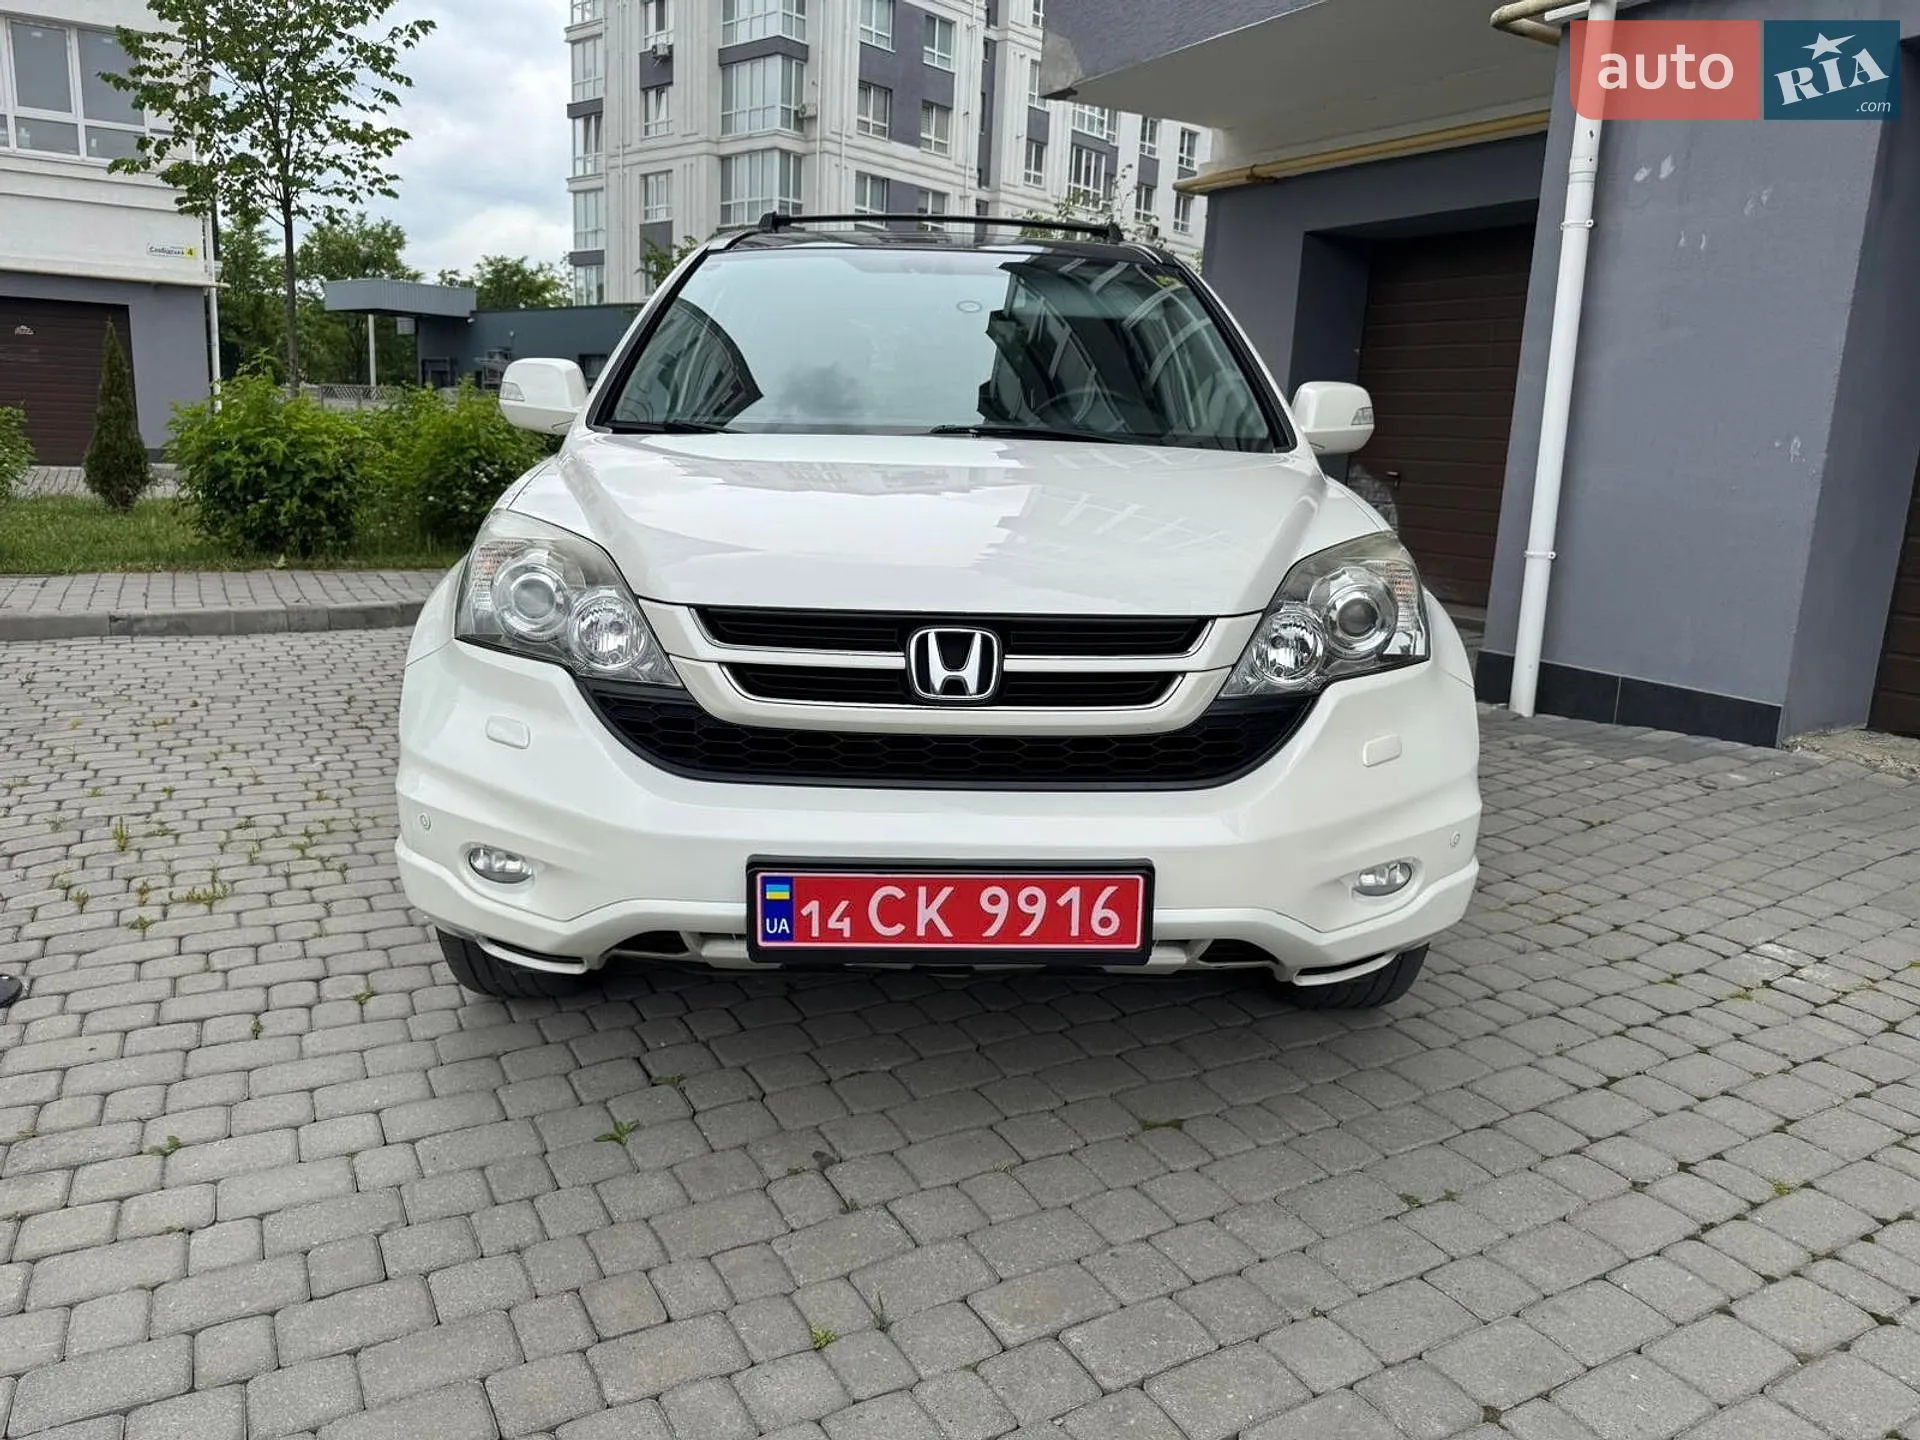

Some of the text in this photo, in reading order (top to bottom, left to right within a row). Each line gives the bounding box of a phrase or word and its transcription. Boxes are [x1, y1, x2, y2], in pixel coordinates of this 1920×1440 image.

[766, 917, 790, 934] UA
[800, 886, 1121, 938] 14 CK 9916
